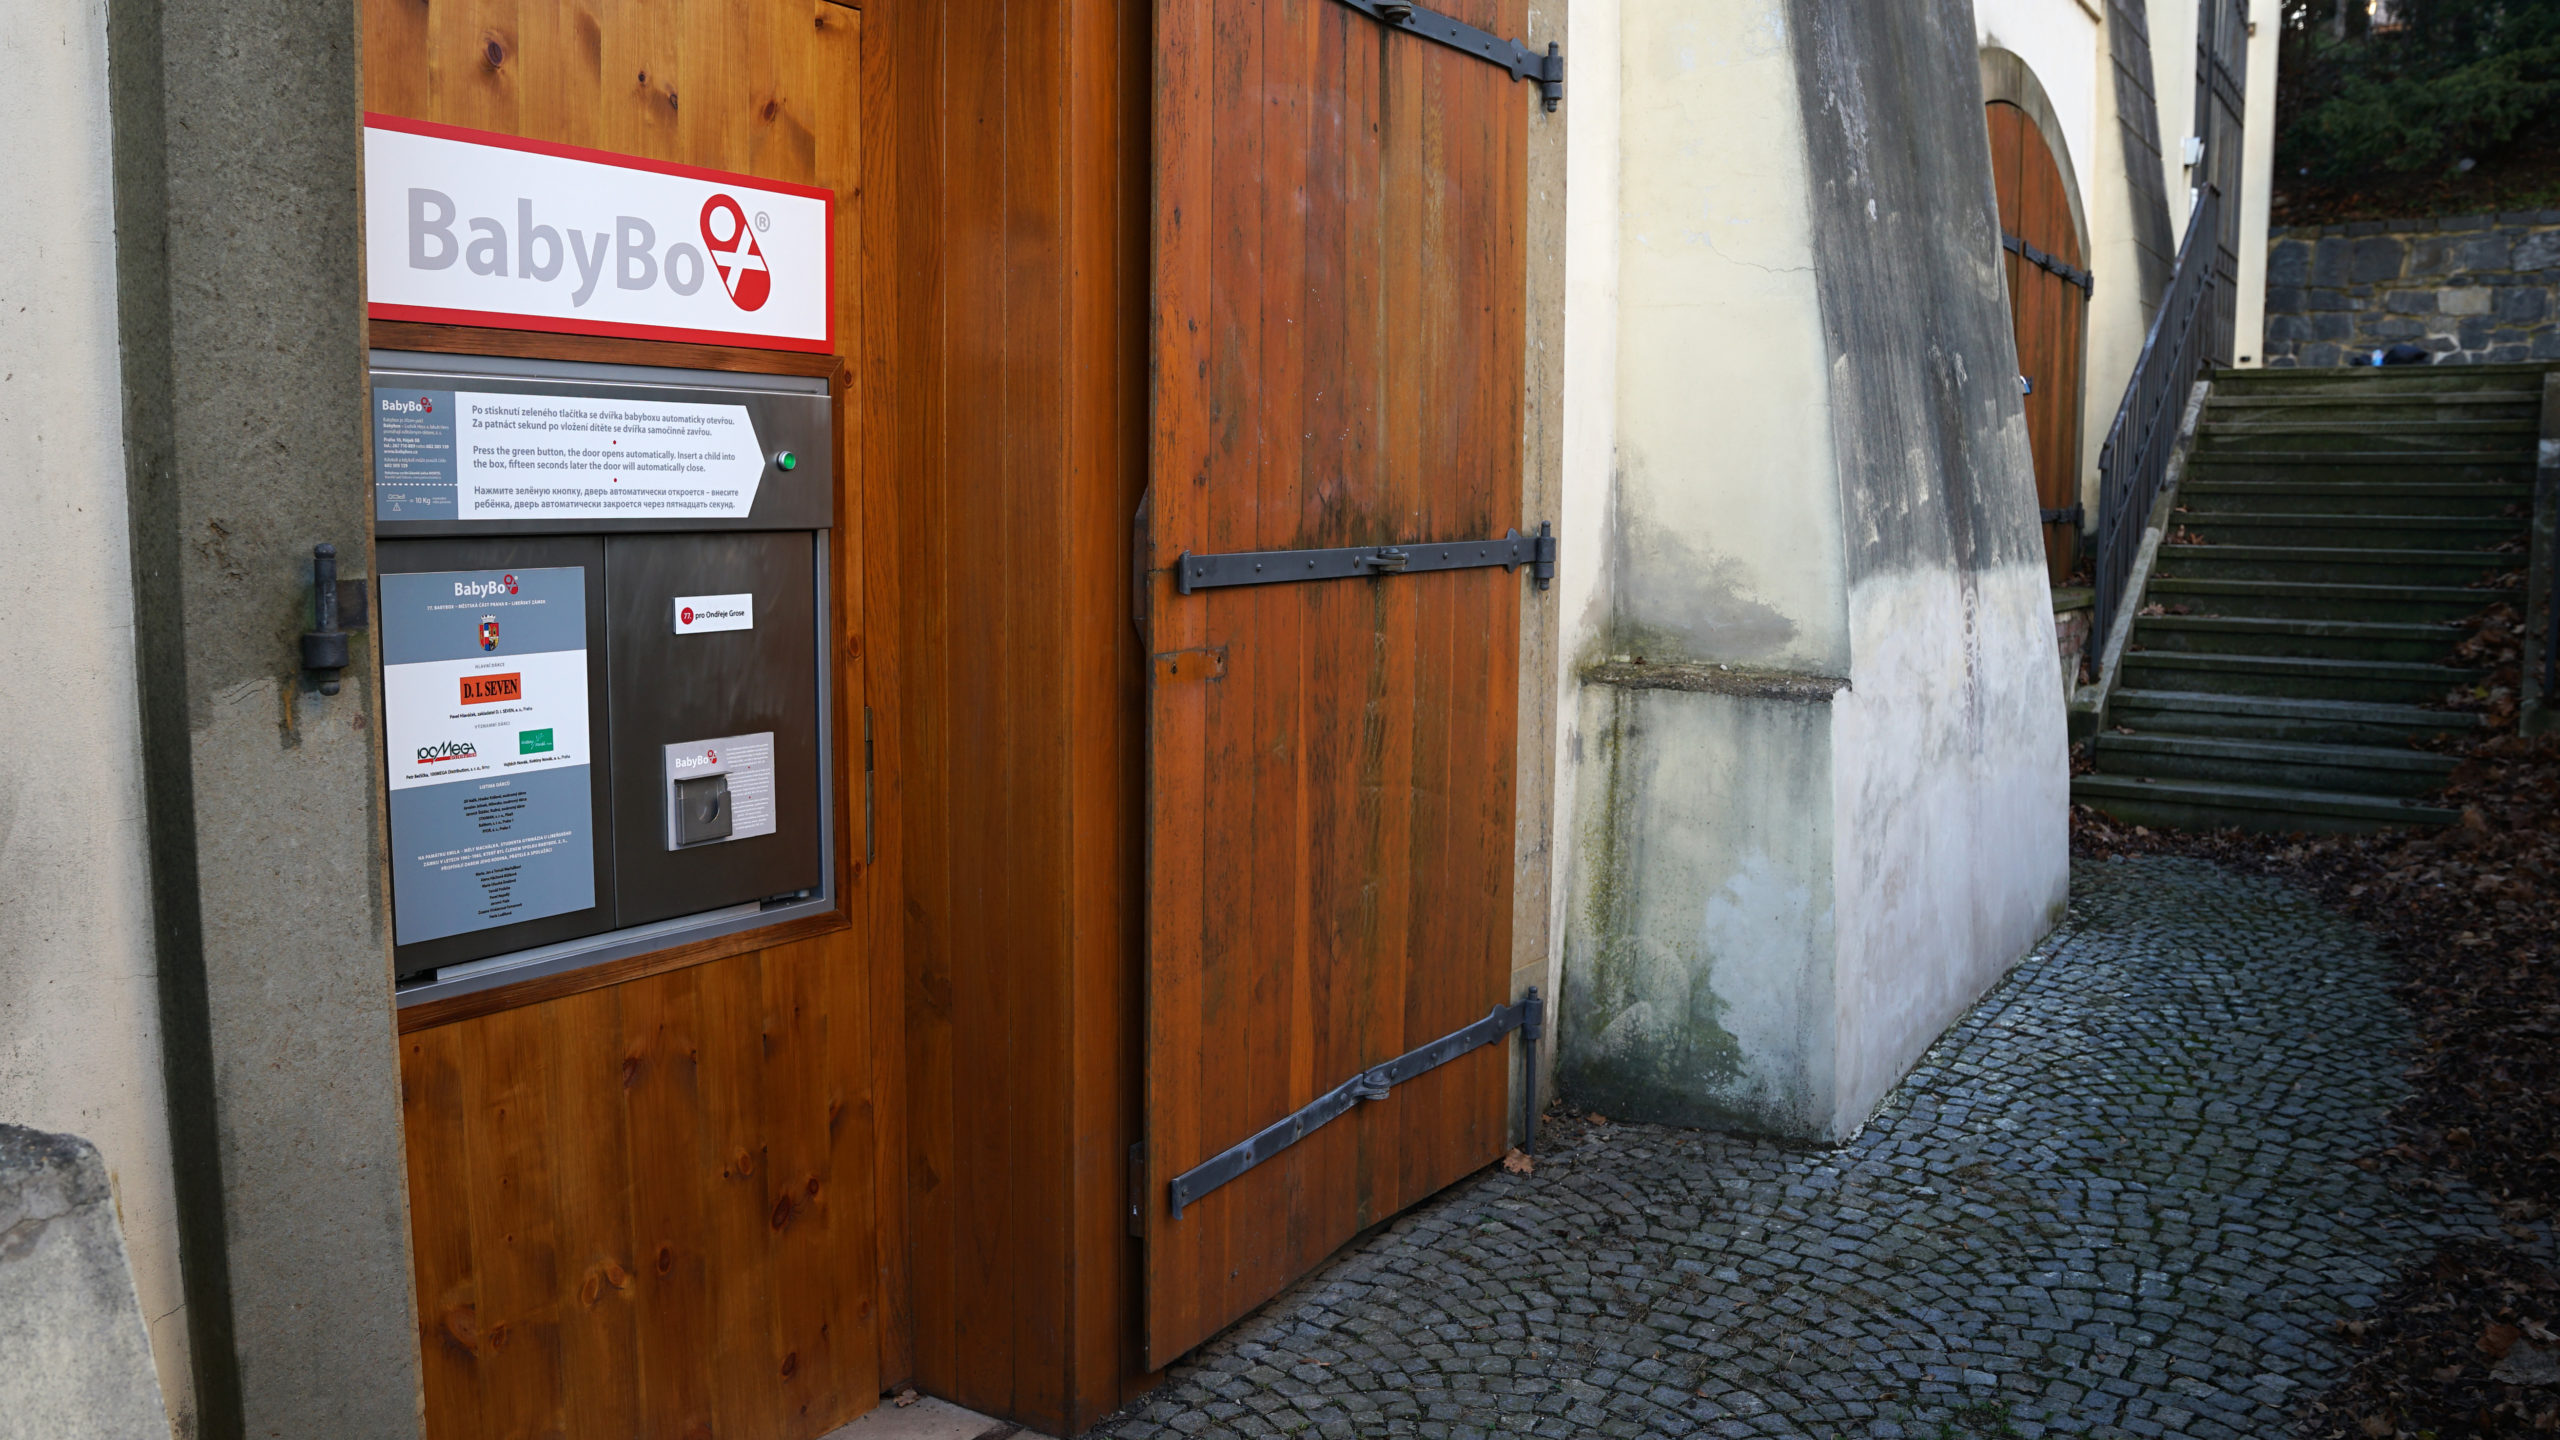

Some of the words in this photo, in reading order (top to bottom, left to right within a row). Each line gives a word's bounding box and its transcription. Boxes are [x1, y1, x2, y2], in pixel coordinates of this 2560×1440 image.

[472, 405, 483, 415] Po
[484, 406, 520, 416] stisknutí
[521, 407, 558, 418] zeleného
[559, 409, 588, 419] tlačítka
[599, 410, 623, 420] dvířka
[624, 411, 661, 423] babyboxu
[661, 414, 706, 425] automaticky
[706, 416, 735, 425] otevřou.
[472, 418, 483, 428] Za
[484, 420, 516, 430] patnáct
[517, 421, 547, 430] sekund
[548, 424, 559, 432] po
[560, 422, 589, 432] vložení
[590, 423, 612, 433] dítěte
[613, 425, 622, 433] se
[623, 425, 646, 434] dvířka
[647, 426, 686, 436] samočinně
[686, 428, 712, 436] zavřou.
[473, 445, 495, 455] Press
[496, 446, 510, 455] the
[511, 447, 535, 457] green
[537, 447, 566, 457] button,
[568, 448, 581, 457] the
[582, 448, 600, 457] door
[602, 450, 624, 459] opens
[625, 449, 676, 461] automatically.
[677, 451, 697, 460] Insert
[704, 452, 721, 461] child
[721, 452, 735, 461] into
[473, 459, 487, 468] the
[489, 459, 507, 469] box,
[508, 459, 535, 469] fifteen
[537, 460, 568, 470] seconds
[569, 461, 587, 470] later
[589, 461, 601, 470] the
[603, 461, 621, 470] door
[622, 462, 635, 471] will
[637, 463, 685, 473] automatically
[686, 463, 706, 472] close.
[474, 486, 513, 495] Нажмите
[515, 486, 550, 497] зелёную
[552, 489, 582, 497] кнопку,
[584, 488, 608, 497] дверь
[609, 488, 666, 496] автоматически
[667, 489, 704, 498] откроется
[474, 499, 512, 510] ребёнка,
[514, 500, 539, 509] дверь
[541, 500, 601, 508] автоматически
[603, 500, 642, 509] закроется
[643, 501, 665, 509] через
[666, 500, 708, 509] пятнадцать
[709, 501, 735, 509] секунд.
[706, 611, 728, 619] Ondřeje
[464, 683, 474, 698] D.
[485, 679, 518, 697] SEVEN
